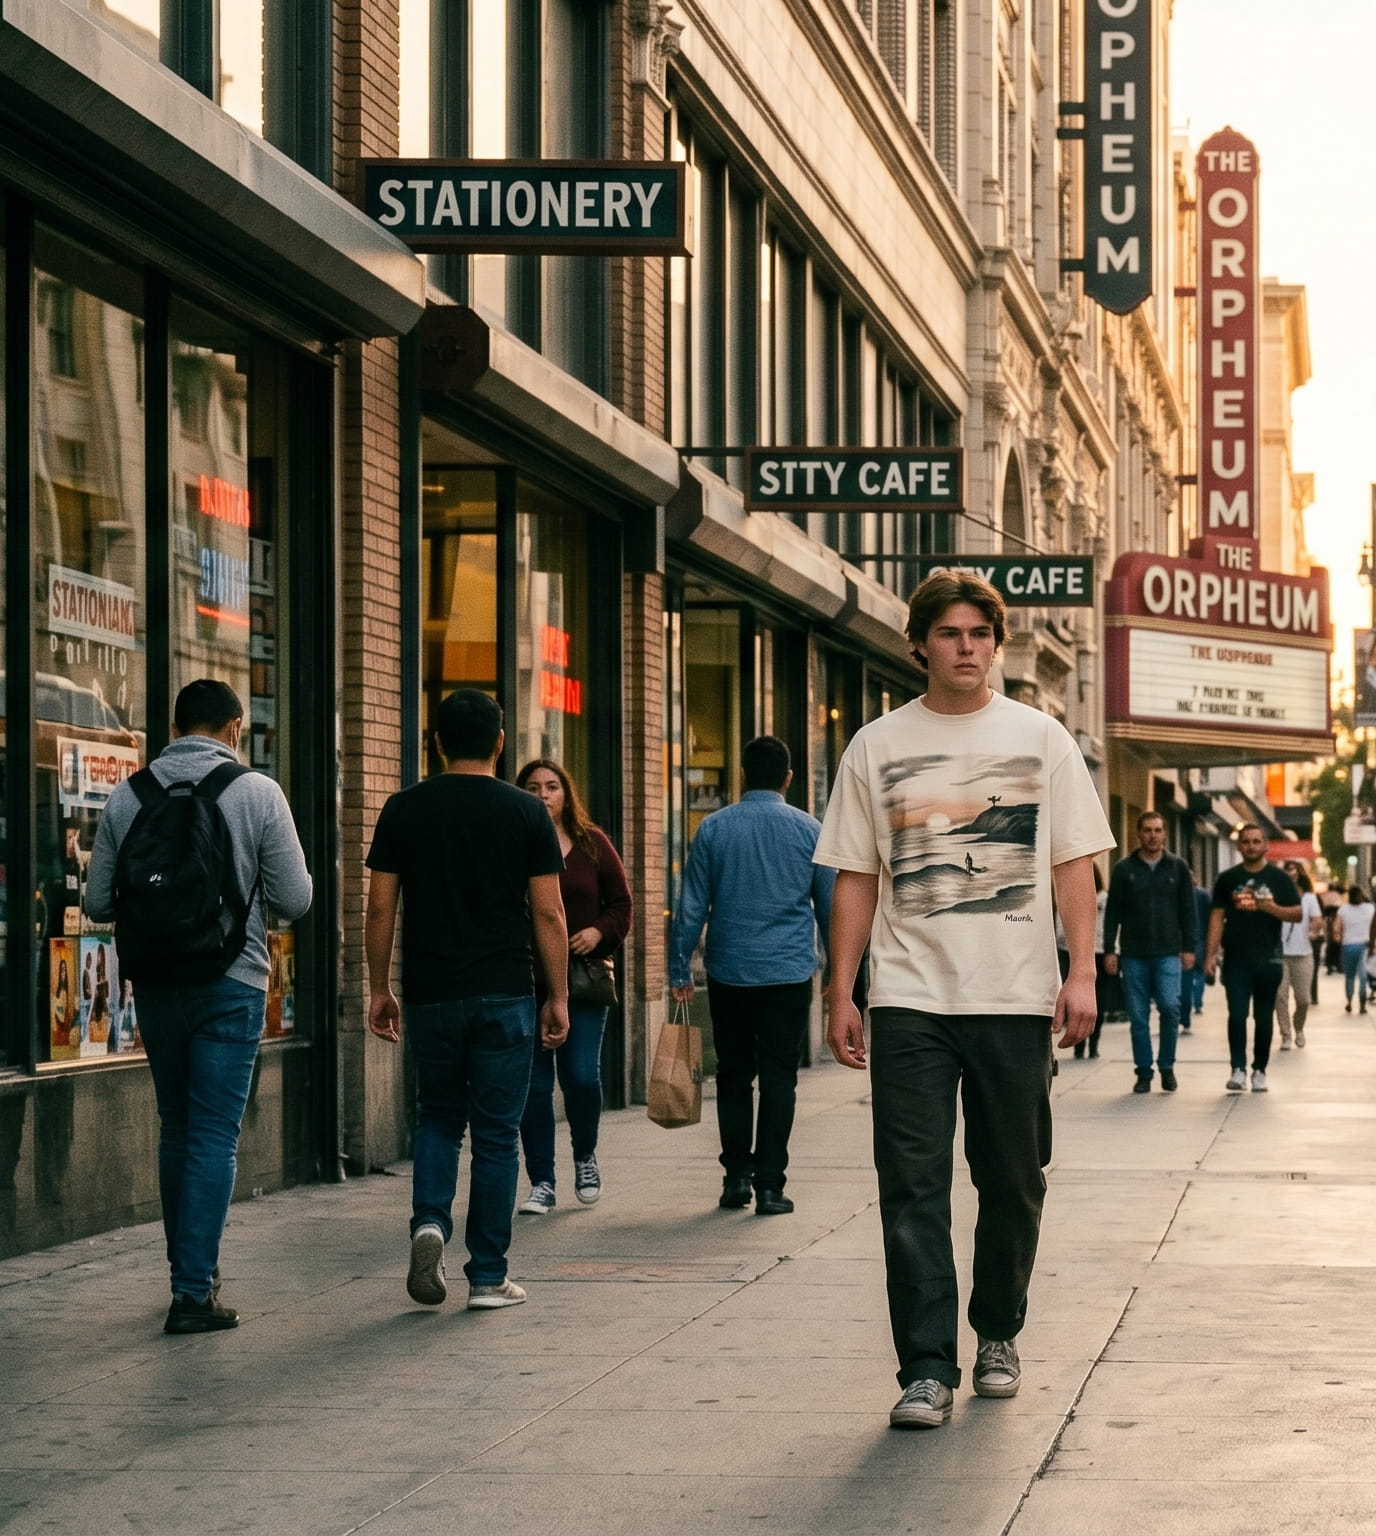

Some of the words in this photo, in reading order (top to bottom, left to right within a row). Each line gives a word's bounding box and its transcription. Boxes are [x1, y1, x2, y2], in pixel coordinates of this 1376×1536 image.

[1204, 151, 1251, 172] THE
[378, 179, 663, 228] STATIONERY
[1208, 188, 1249, 528] ORPHEUM
[858, 461, 950, 495] CAFE
[1216, 543, 1252, 571] THE
[1006, 566, 1084, 595] CAFE
[1143, 565, 1319, 633] ORPHEUM
